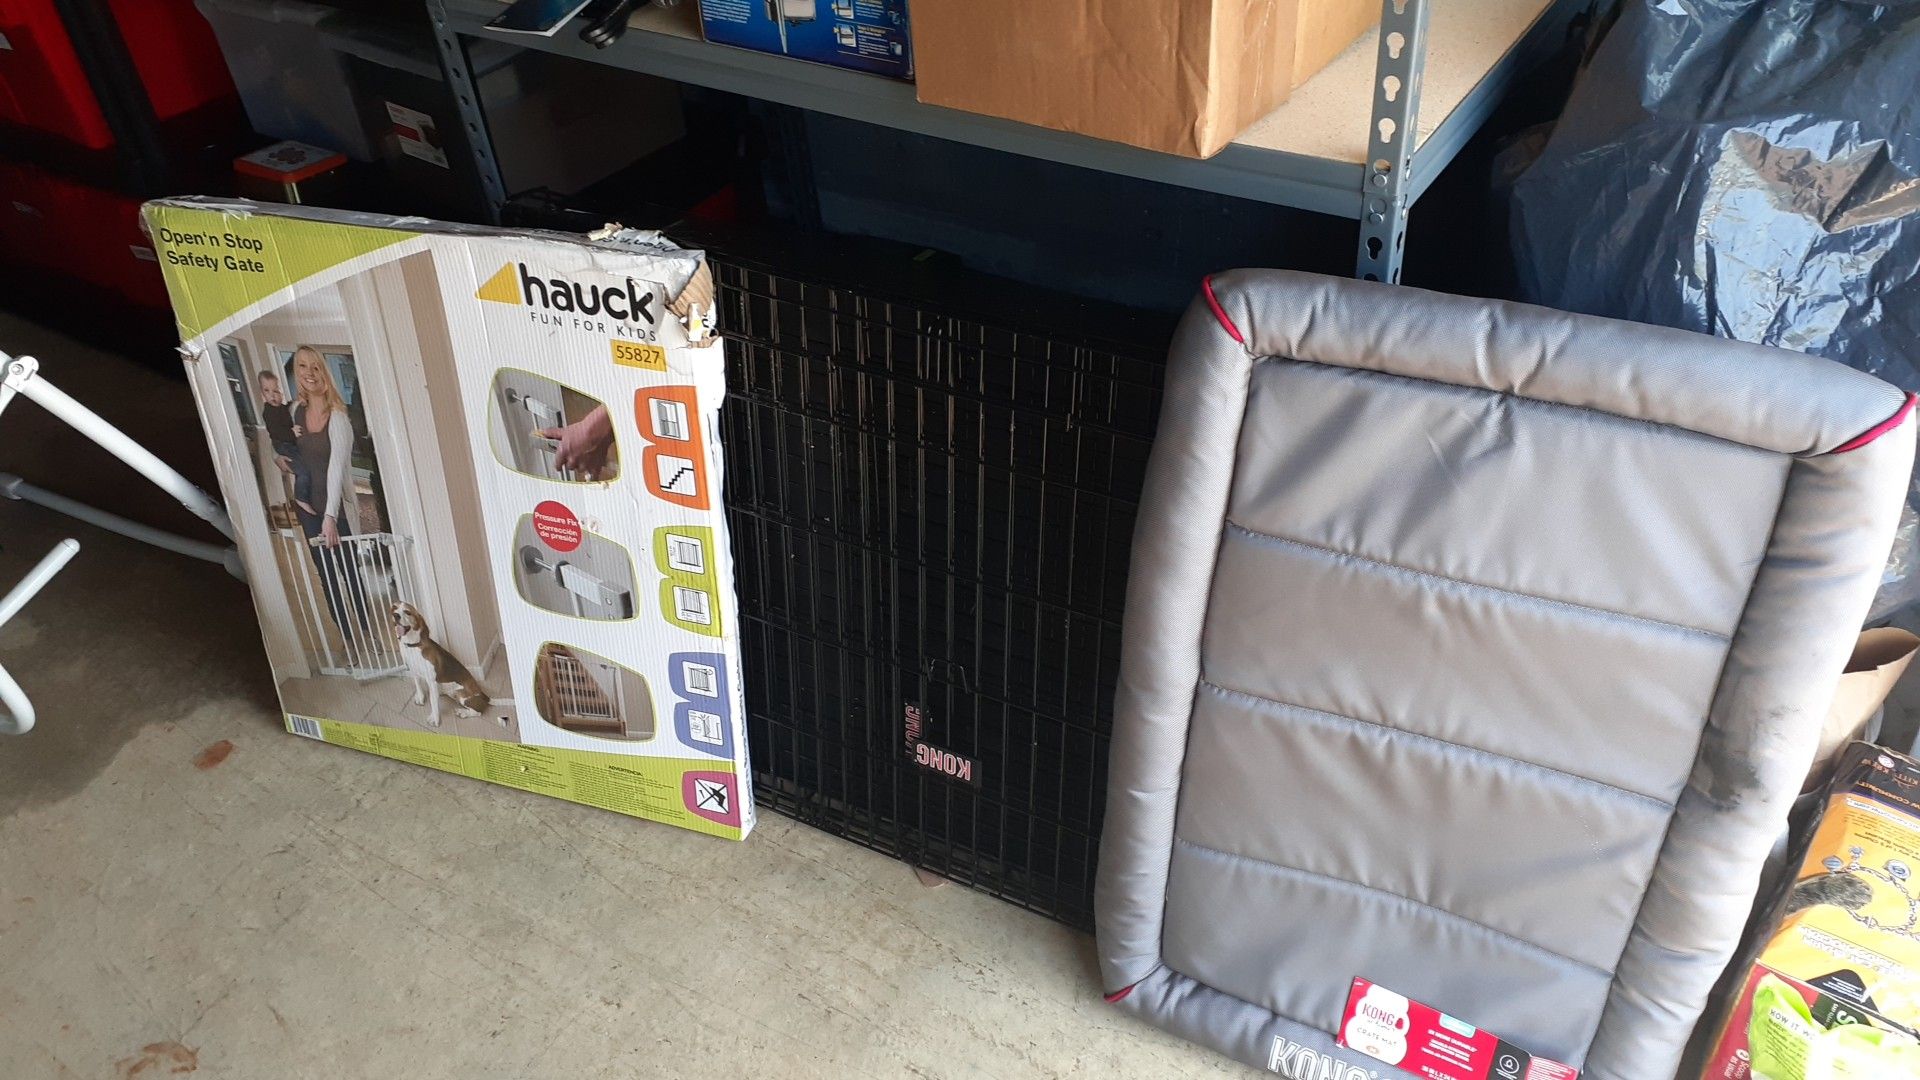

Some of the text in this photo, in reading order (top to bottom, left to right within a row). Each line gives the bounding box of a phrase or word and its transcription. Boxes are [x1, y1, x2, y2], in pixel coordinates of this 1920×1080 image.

[223, 233, 263, 254] Stop
[166, 250, 265, 273] Safety Gate
[518, 262, 655, 325] hauck
[531, 311, 657, 342] FUN FOR KIDS
[616, 345, 660, 364] 55827
[534, 511, 567, 525] Pressure
[916, 743, 971, 781] KONG
[1362, 1002, 1395, 1026] KONG
